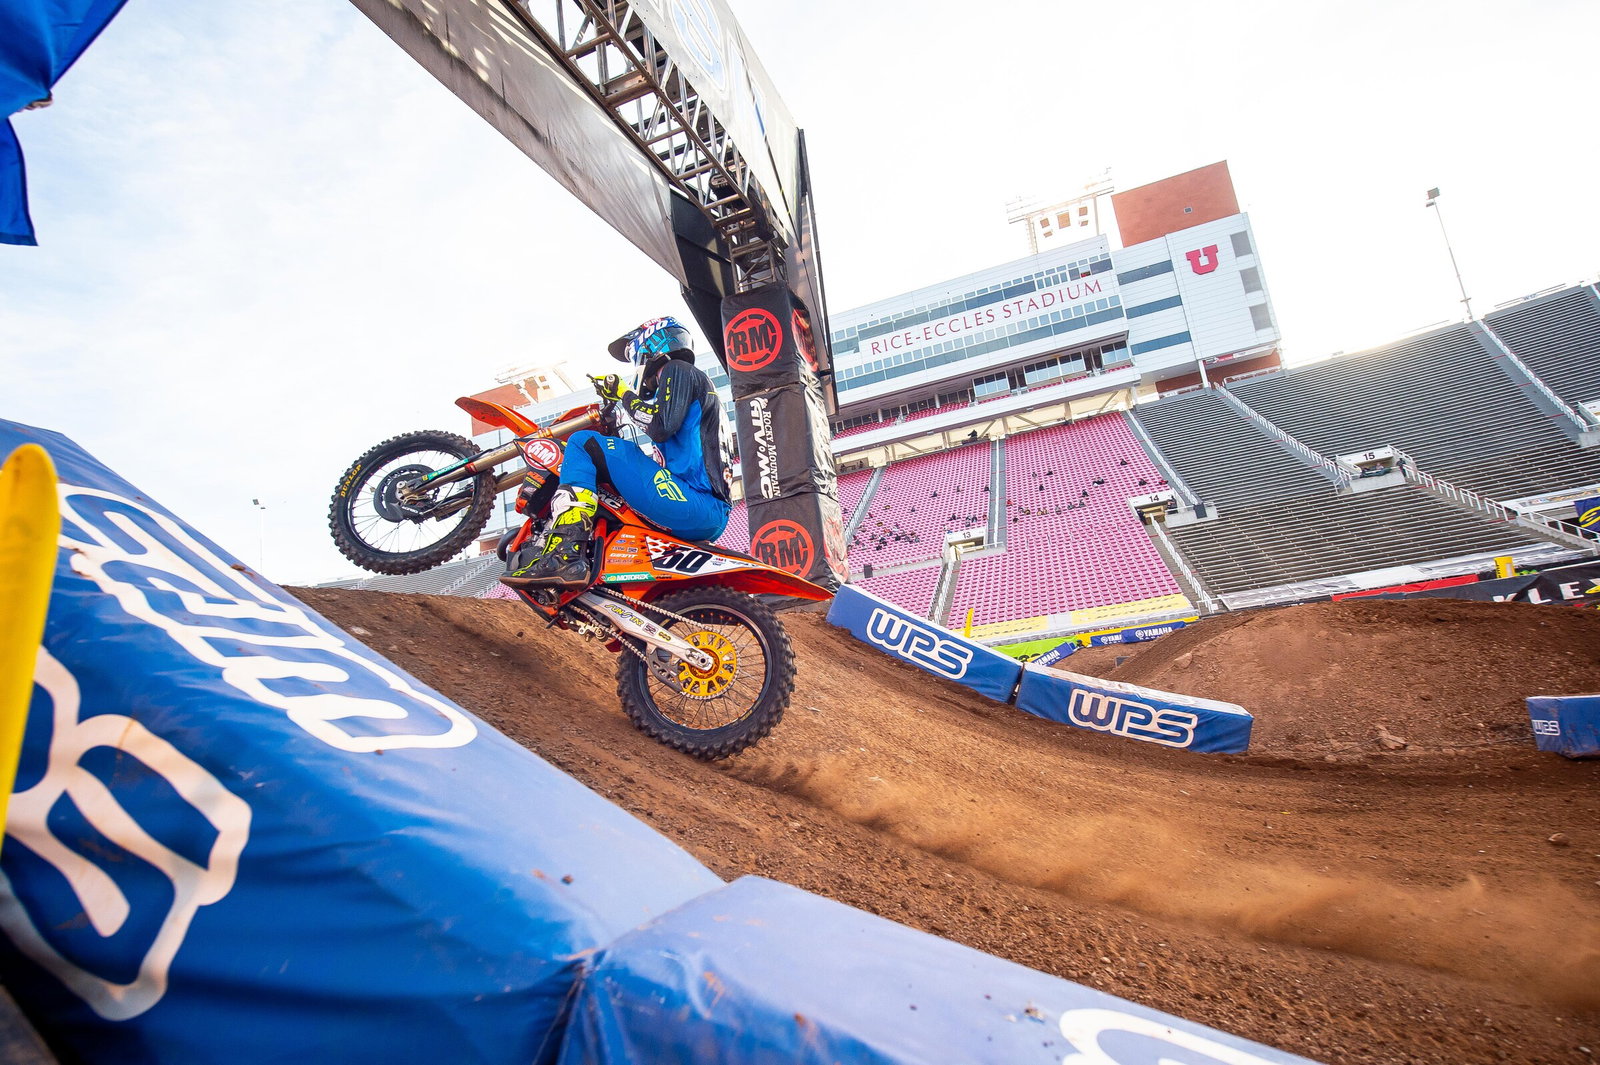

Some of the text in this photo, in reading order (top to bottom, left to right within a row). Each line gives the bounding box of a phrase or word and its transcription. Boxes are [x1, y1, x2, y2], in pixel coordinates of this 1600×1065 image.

[1185, 243, 1219, 275] U
[870, 279, 1102, 356] RICE-ECCLES STADIUM
[762, 410, 781, 497] ROCKY MOUNTAIN
[1363, 452, 1376, 461] 15
[340, 464, 362, 498] DUNLOP
[1148, 494, 1160, 503] 14
[962, 530, 972, 539] 13
[866, 607, 974, 680] WPS
[1143, 626, 1173, 639] YAMAHA
[1068, 688, 1199, 748] WPS
